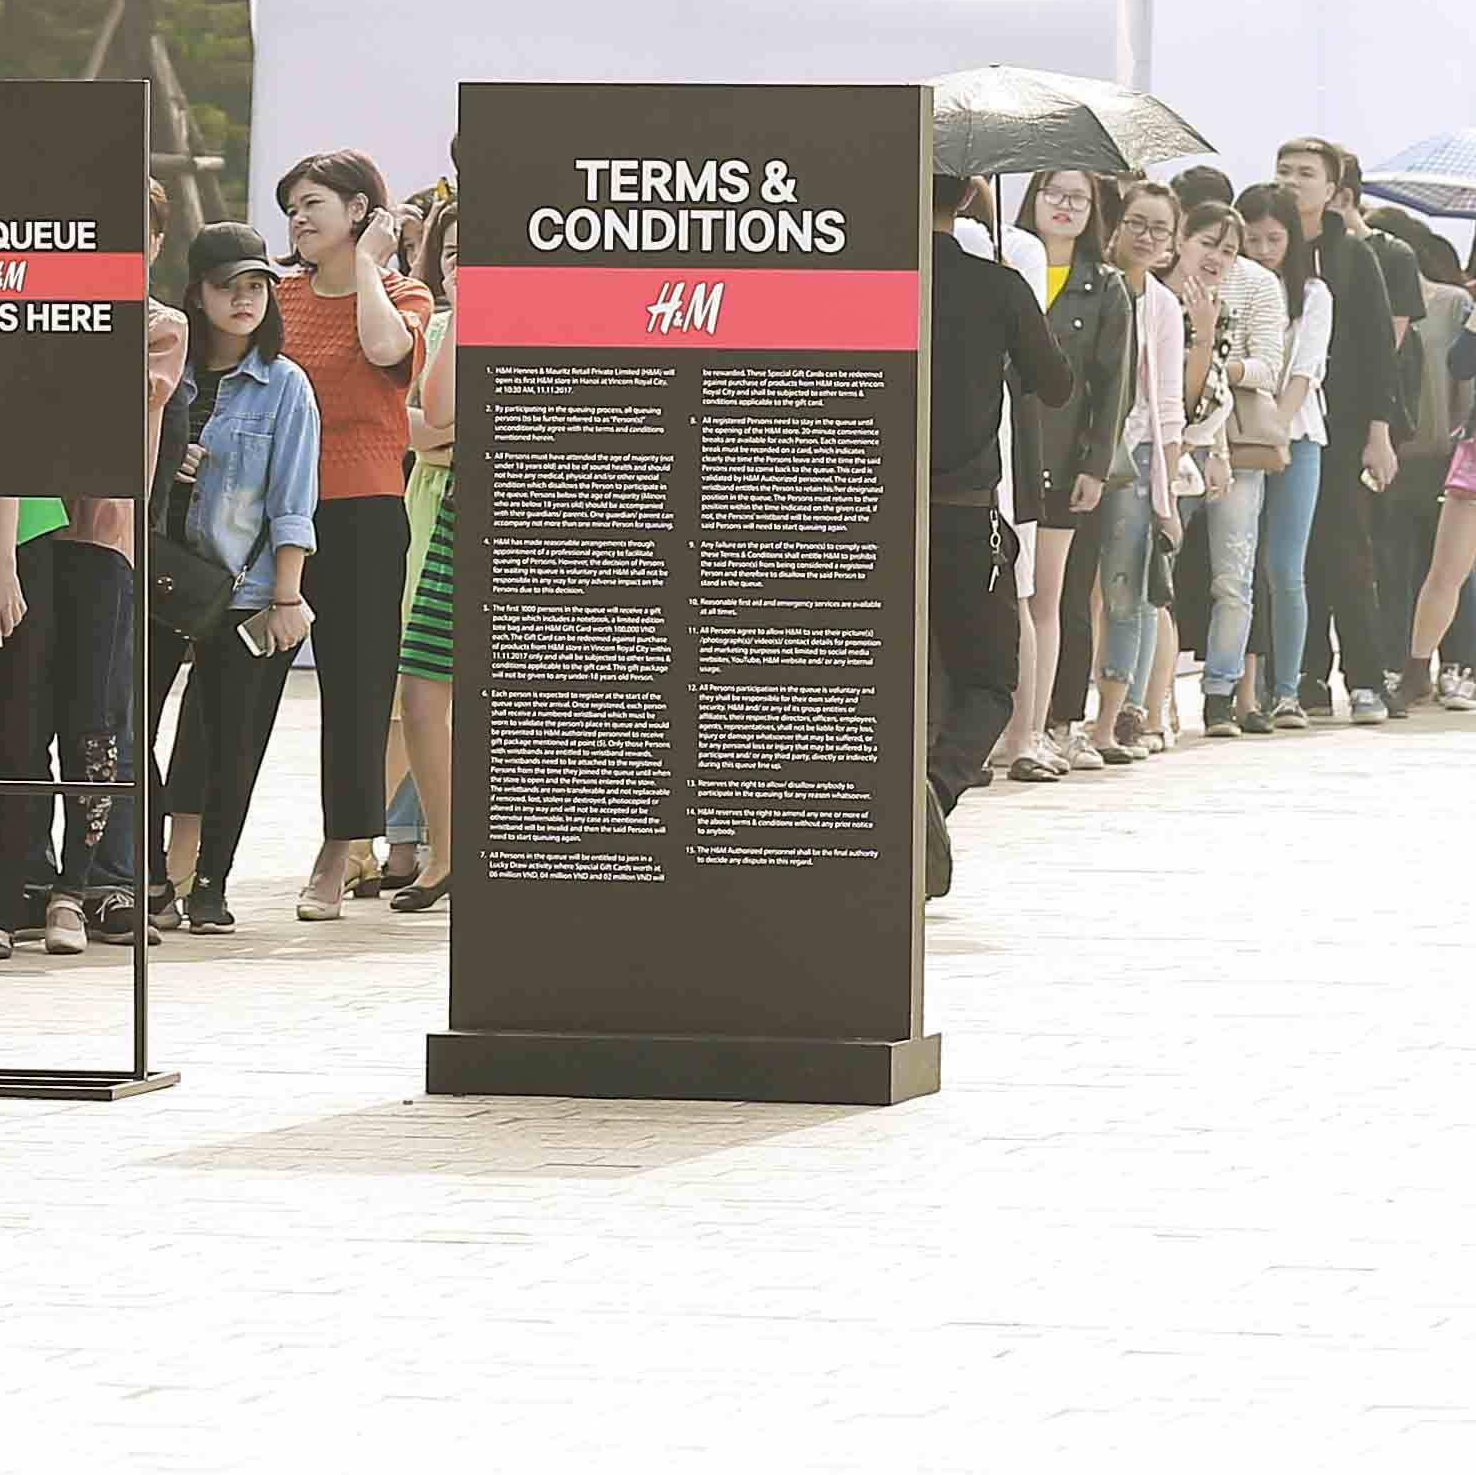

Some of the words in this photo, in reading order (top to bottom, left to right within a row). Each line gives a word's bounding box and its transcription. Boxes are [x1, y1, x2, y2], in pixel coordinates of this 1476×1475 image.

[575, 159, 751, 203] TERMS
[760, 159, 799, 204] &
[528, 207, 846, 252] CONDITIONS
[26, 302, 112, 333] HERE
[646, 281, 725, 335] H&M
